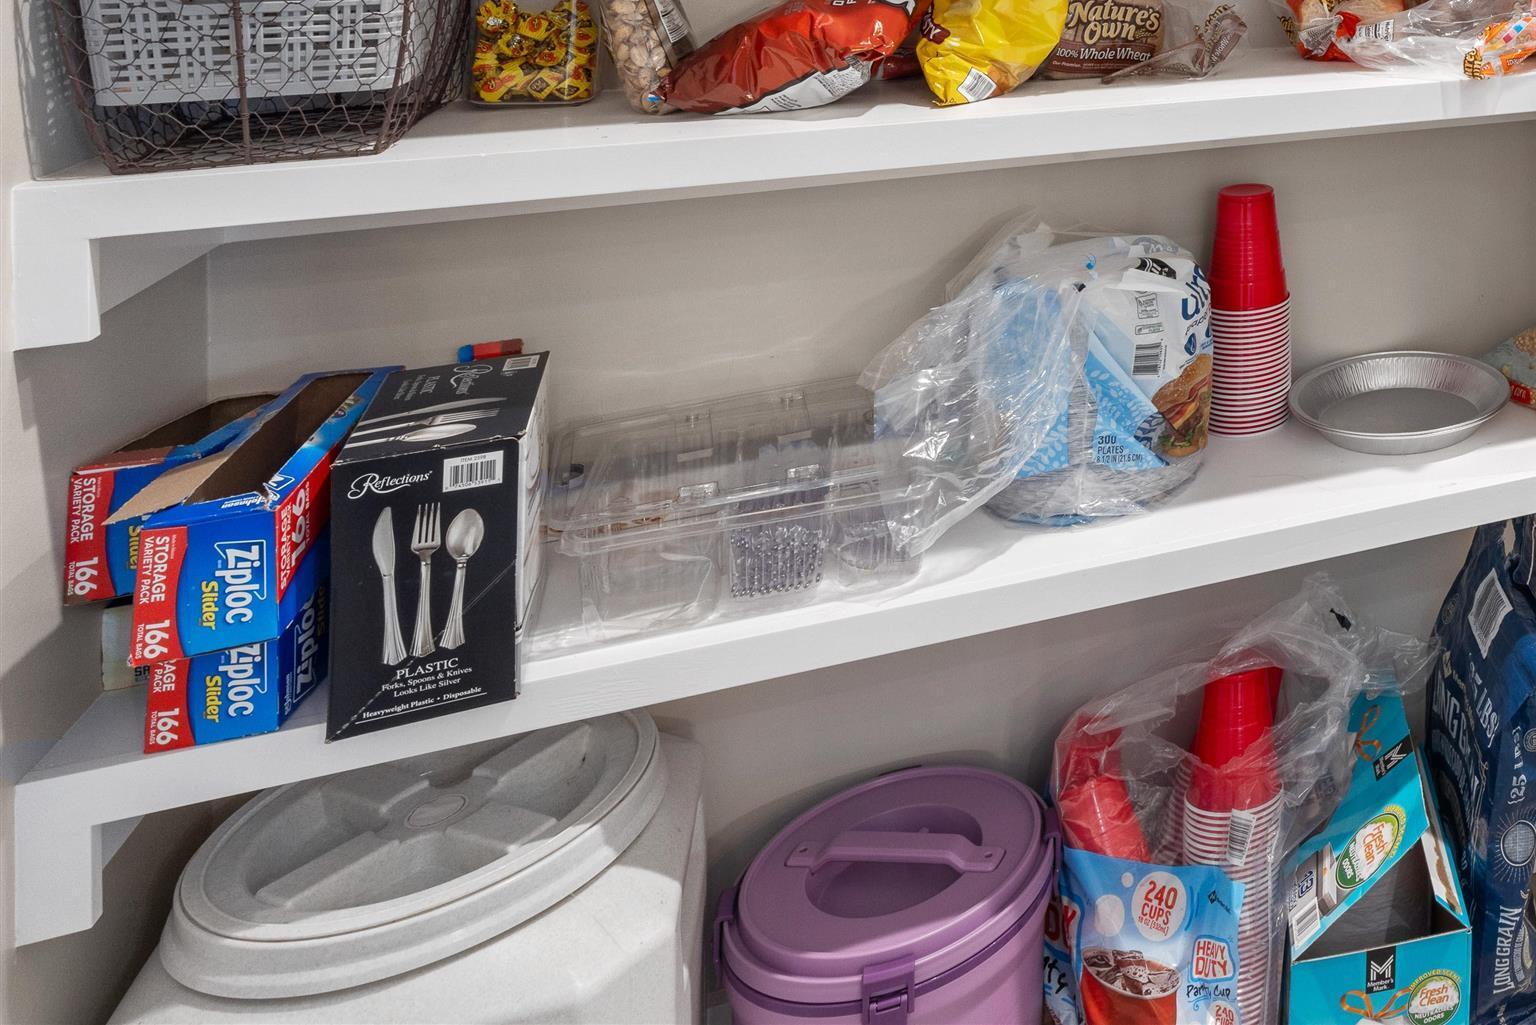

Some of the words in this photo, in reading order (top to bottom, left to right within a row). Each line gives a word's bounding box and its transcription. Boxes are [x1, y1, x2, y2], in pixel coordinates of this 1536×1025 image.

[1068, 0, 1161, 31] Nature's
[1083, 21, 1135, 44] Own
[1056, 47, 1078, 58] 100%
[1080, 48, 1114, 60] Whole
[1115, 47, 1152, 62] Wheat
[1097, 435, 1117, 446] 300
[1097, 445, 1124, 455] PLATES
[72, 478, 83, 515] VARIETY
[348, 471, 433, 499] Reflections
[80, 477, 96, 542] STORAGE
[70, 517, 80, 543] PACK
[291, 488, 306, 567] 166
[141, 536, 155, 576] VARIETY
[280, 506, 289, 590] STORAGE
[68, 561, 76, 579] TOTAL
[74, 556, 98, 596] 166
[150, 536, 169, 602] STORAGE
[139, 578, 150, 604] PACK
[215, 545, 260, 624] Ziploc
[201, 580, 219, 630] Slider
[136, 623, 145, 641] TOTAL
[143, 619, 170, 659] 166
[152, 668, 163, 693] PACK
[218, 643, 261, 717] Ziploc
[381, 681, 406, 692] Forks,
[407, 675, 435, 686] Spoons
[446, 667, 473, 677] Knives
[396, 658, 459, 679] PLASTIC
[205, 675, 222, 723] Slider
[393, 687, 418, 698] Looks
[419, 683, 437, 692] Like
[438, 677, 461, 688] Silver
[362, 703, 410, 719] Heavyweight
[410, 697, 435, 708] Plastic
[442, 686, 482, 701] Disposable
[155, 708, 180, 745] 166
[1363, 832, 1374, 865] Clean
[1371, 822, 1388, 857] Fresh
[1342, 858, 1354, 879] ODORS
[1143, 880, 1178, 909] 240
[1141, 905, 1172, 923] CUPS
[1496, 905, 1523, 956] GRAIN
[1196, 940, 1226, 958] HEAVY
[1193, 957, 1228, 977] DUTY
[1493, 957, 1515, 995] LONG
[1186, 982, 1211, 999] Party
[1213, 985, 1231, 998] Cup
[1367, 979, 1395, 989] Member's
[1373, 984, 1389, 993] Mark
[1419, 984, 1449, 999] Fresh
[1215, 1005, 1234, 1021] 240
[1418, 993, 1449, 1007] Clean
[1423, 1012, 1445, 1025] ODORS
